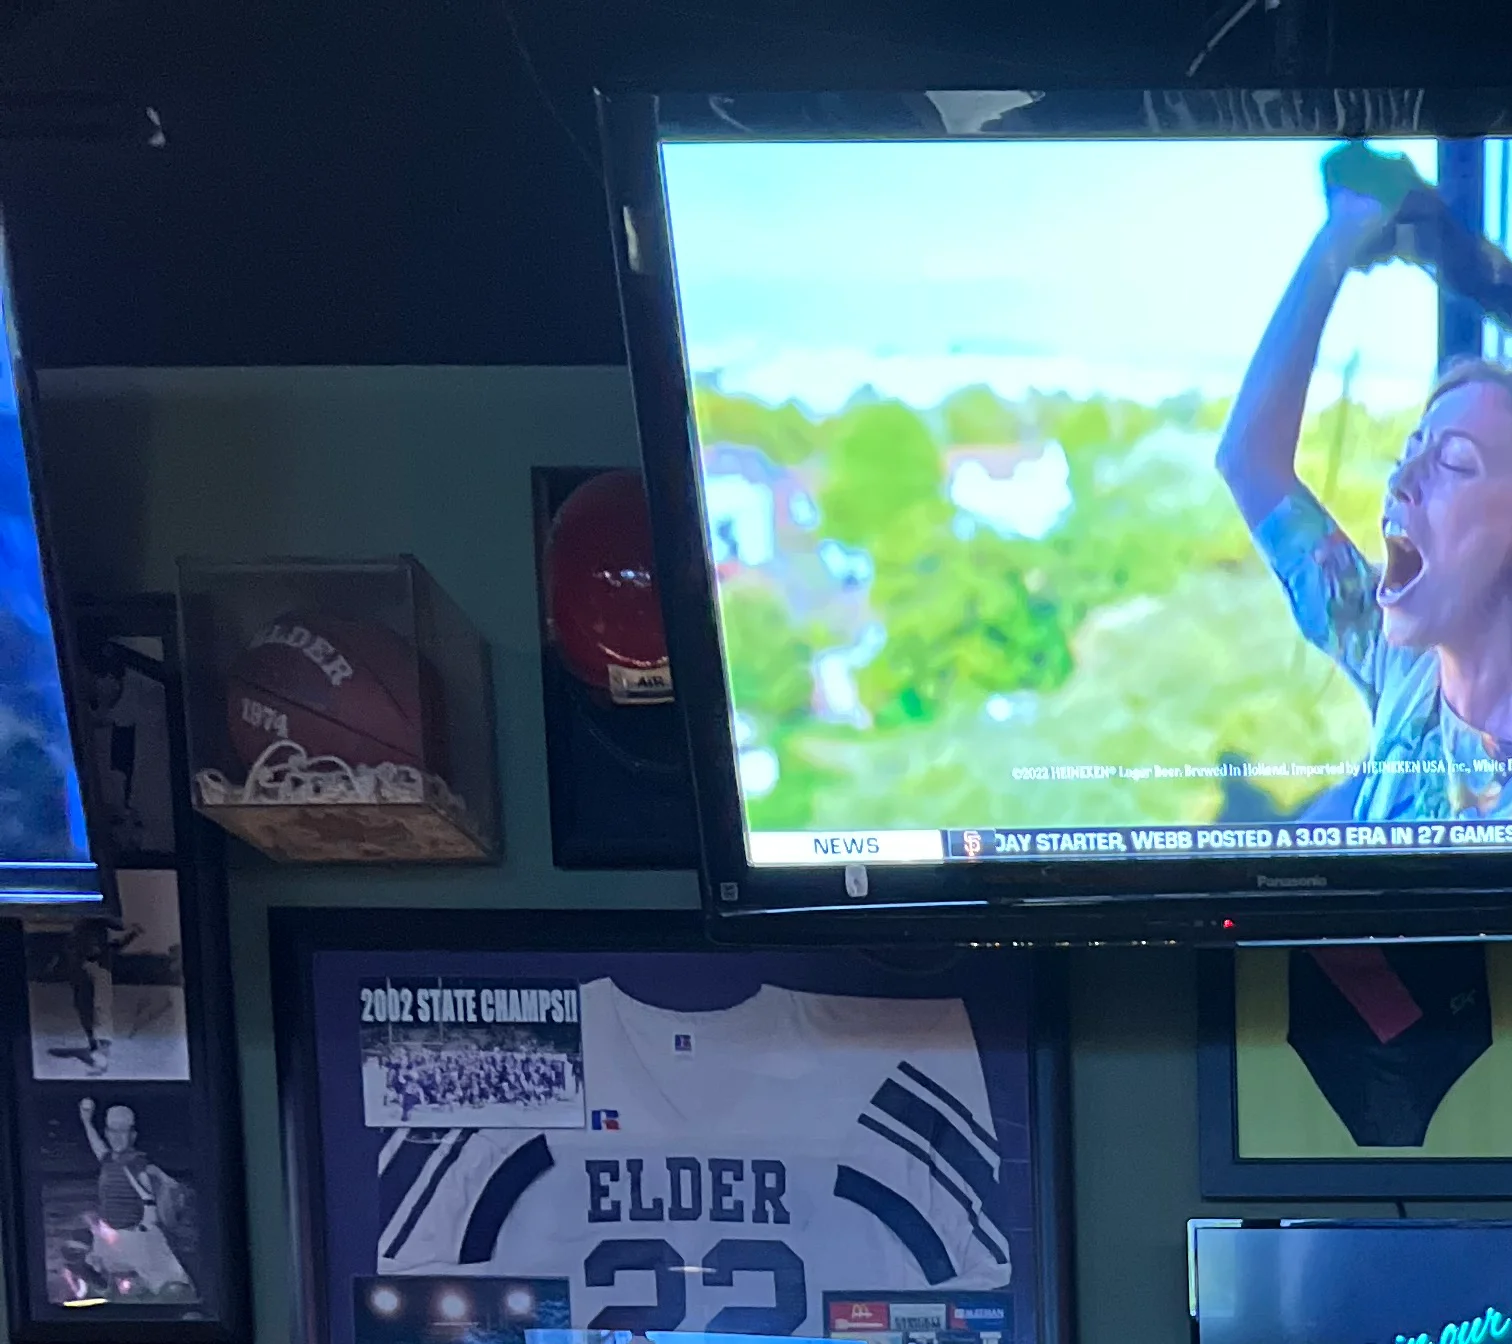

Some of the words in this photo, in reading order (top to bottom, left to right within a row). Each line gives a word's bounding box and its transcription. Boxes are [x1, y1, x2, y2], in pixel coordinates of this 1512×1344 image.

[1422, 759, 1445, 773] USA
[1473, 758, 1505, 772] White
[813, 837, 880, 854] NEWS
[1036, 832, 1127, 853] STARTER,
[1197, 829, 1273, 850] POSTED
[1276, 828, 1293, 848] A
[1296, 827, 1342, 847] 3.03
[1345, 827, 1386, 847] ERA
[1391, 826, 1412, 845] IN
[1417, 825, 1445, 846] 27
[360, 987, 414, 1023] 2002
[416, 988, 478, 1023] STATE
[585, 1156, 791, 1225] ELDER
